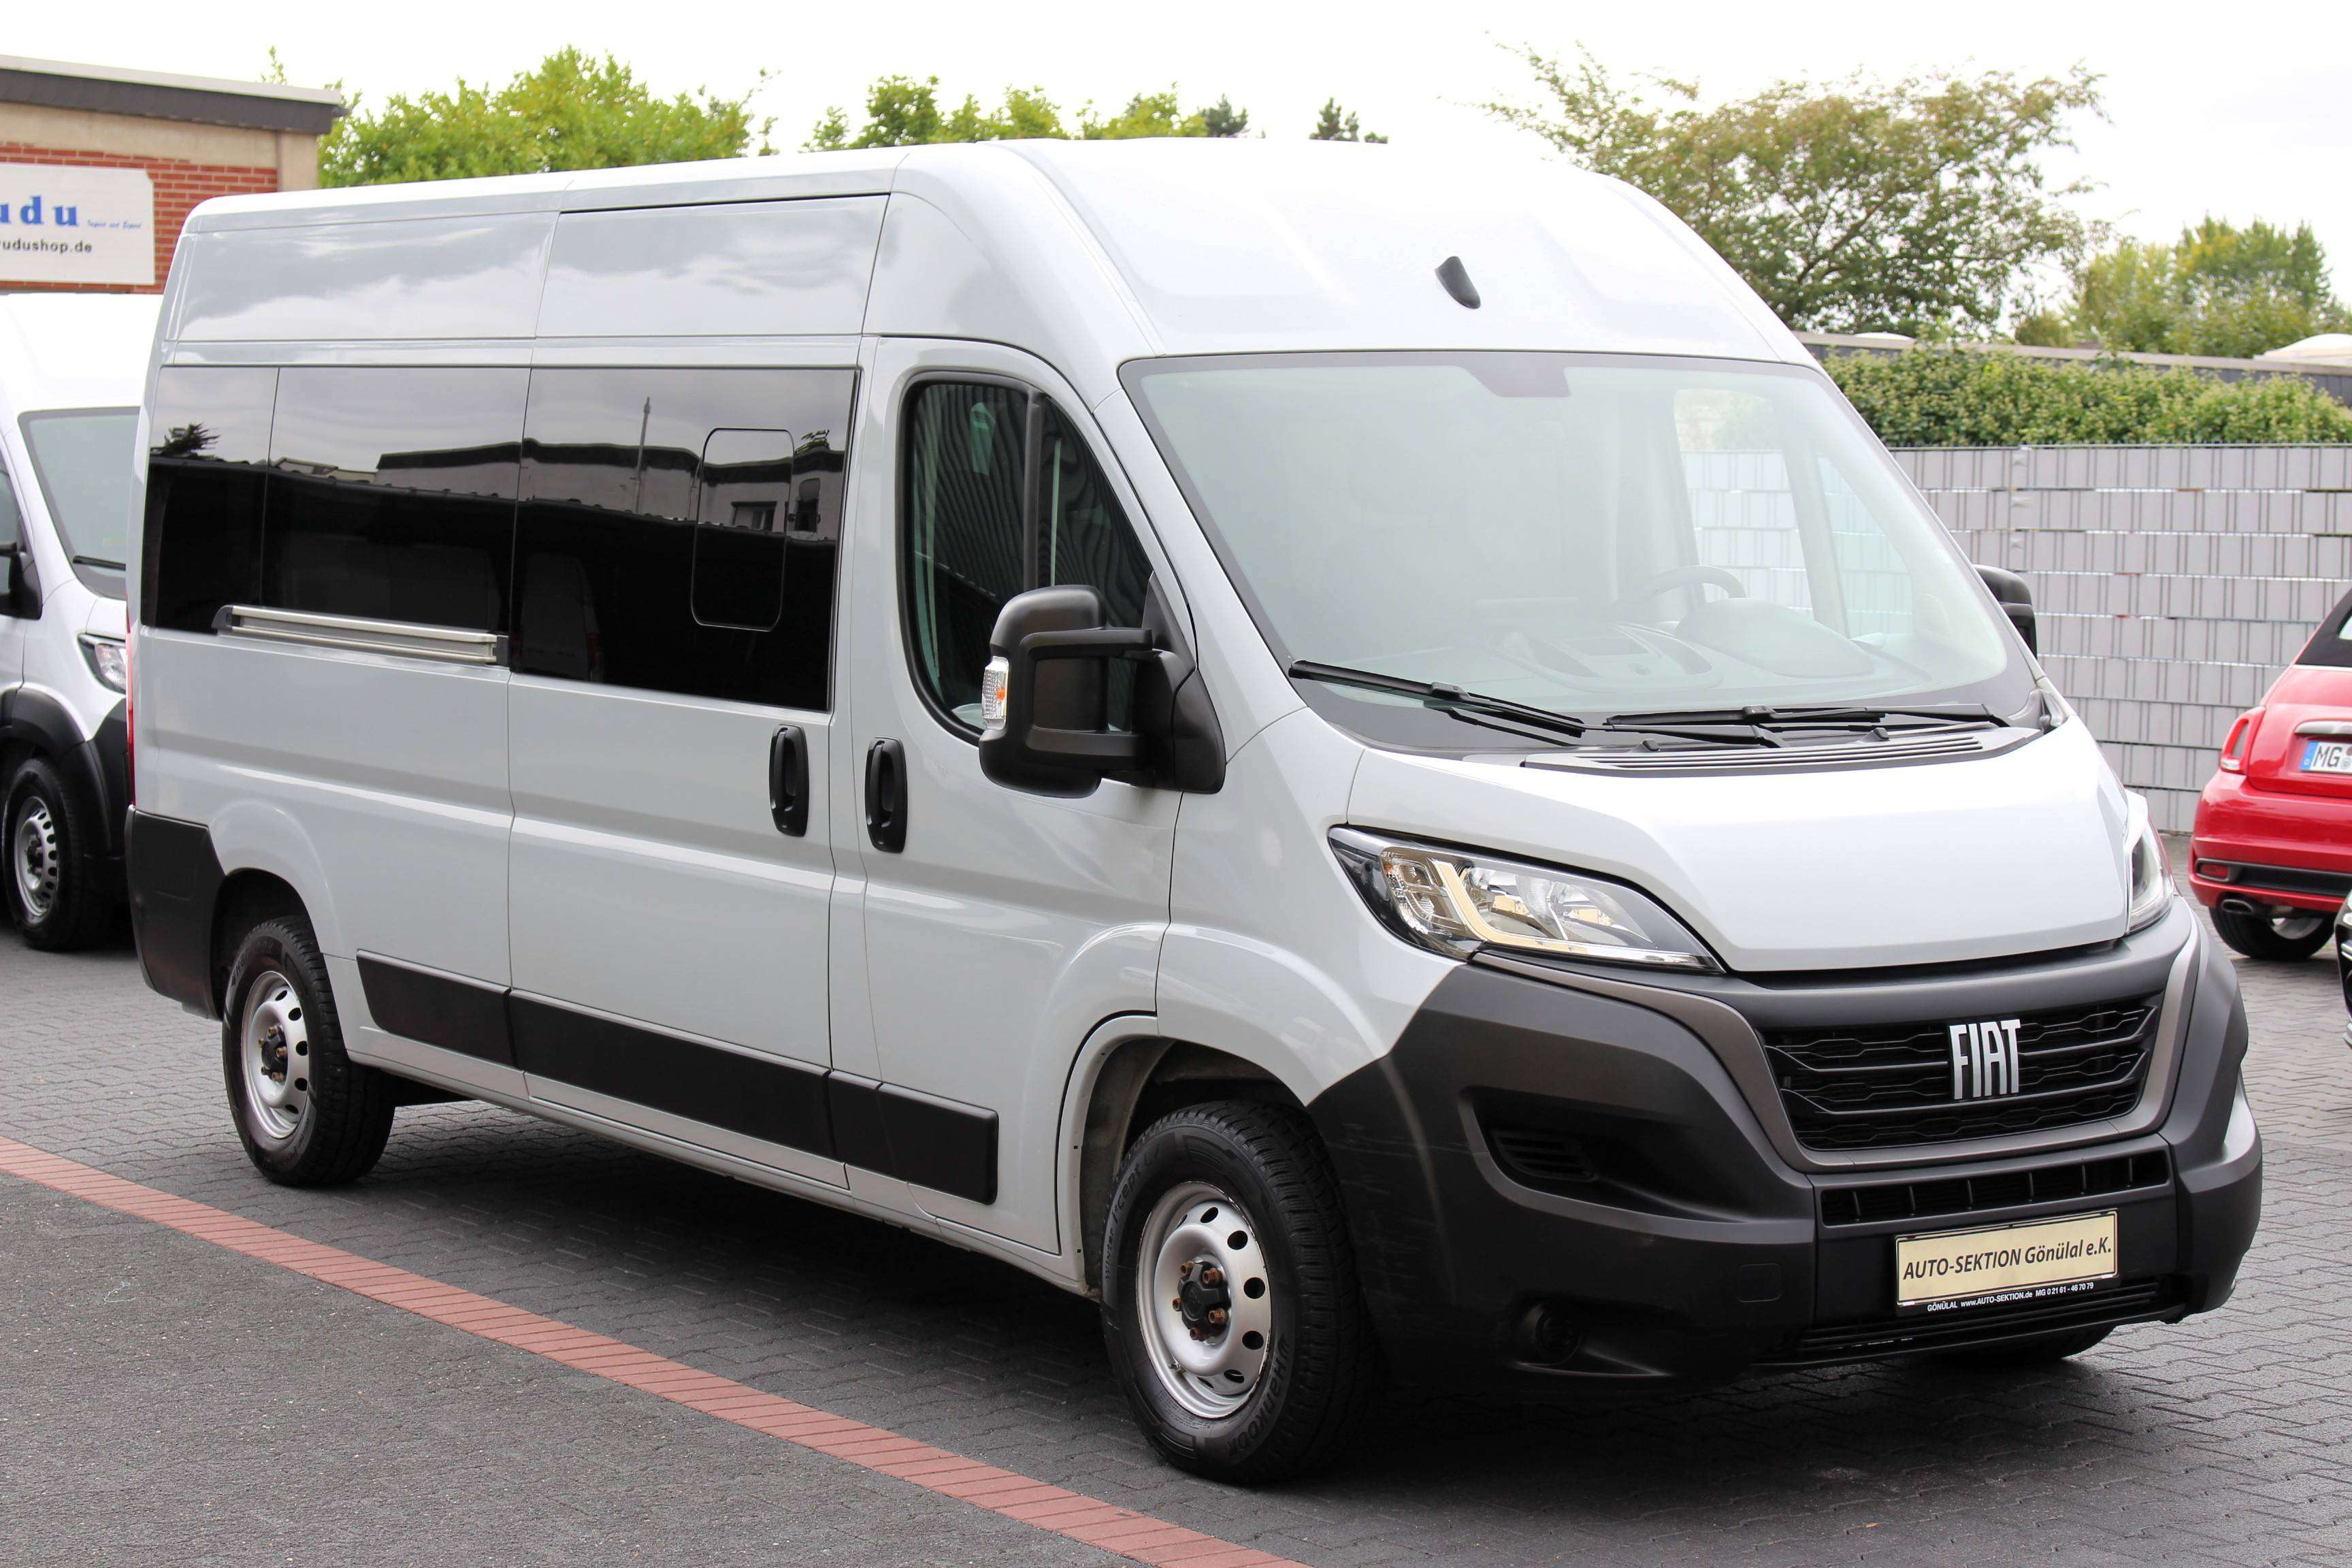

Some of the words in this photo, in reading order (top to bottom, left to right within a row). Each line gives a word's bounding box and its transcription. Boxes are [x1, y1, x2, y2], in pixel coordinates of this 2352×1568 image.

[0, 238, 93, 255] udushop.de
[2313, 745, 2342, 768] MG
[1948, 1019, 2021, 1100] FIAT
[1902, 1247, 2021, 1280] AUTO-SEKTION
[2025, 1239, 2083, 1264] Gönülal
[2085, 1236, 2112, 1256] e.K.
[1927, 1301, 1958, 1311] GÖNÜLAL
[1960, 1291, 2033, 1307] www.AUTO-SEKTION.de
[2035, 1288, 2046, 1297] MG
